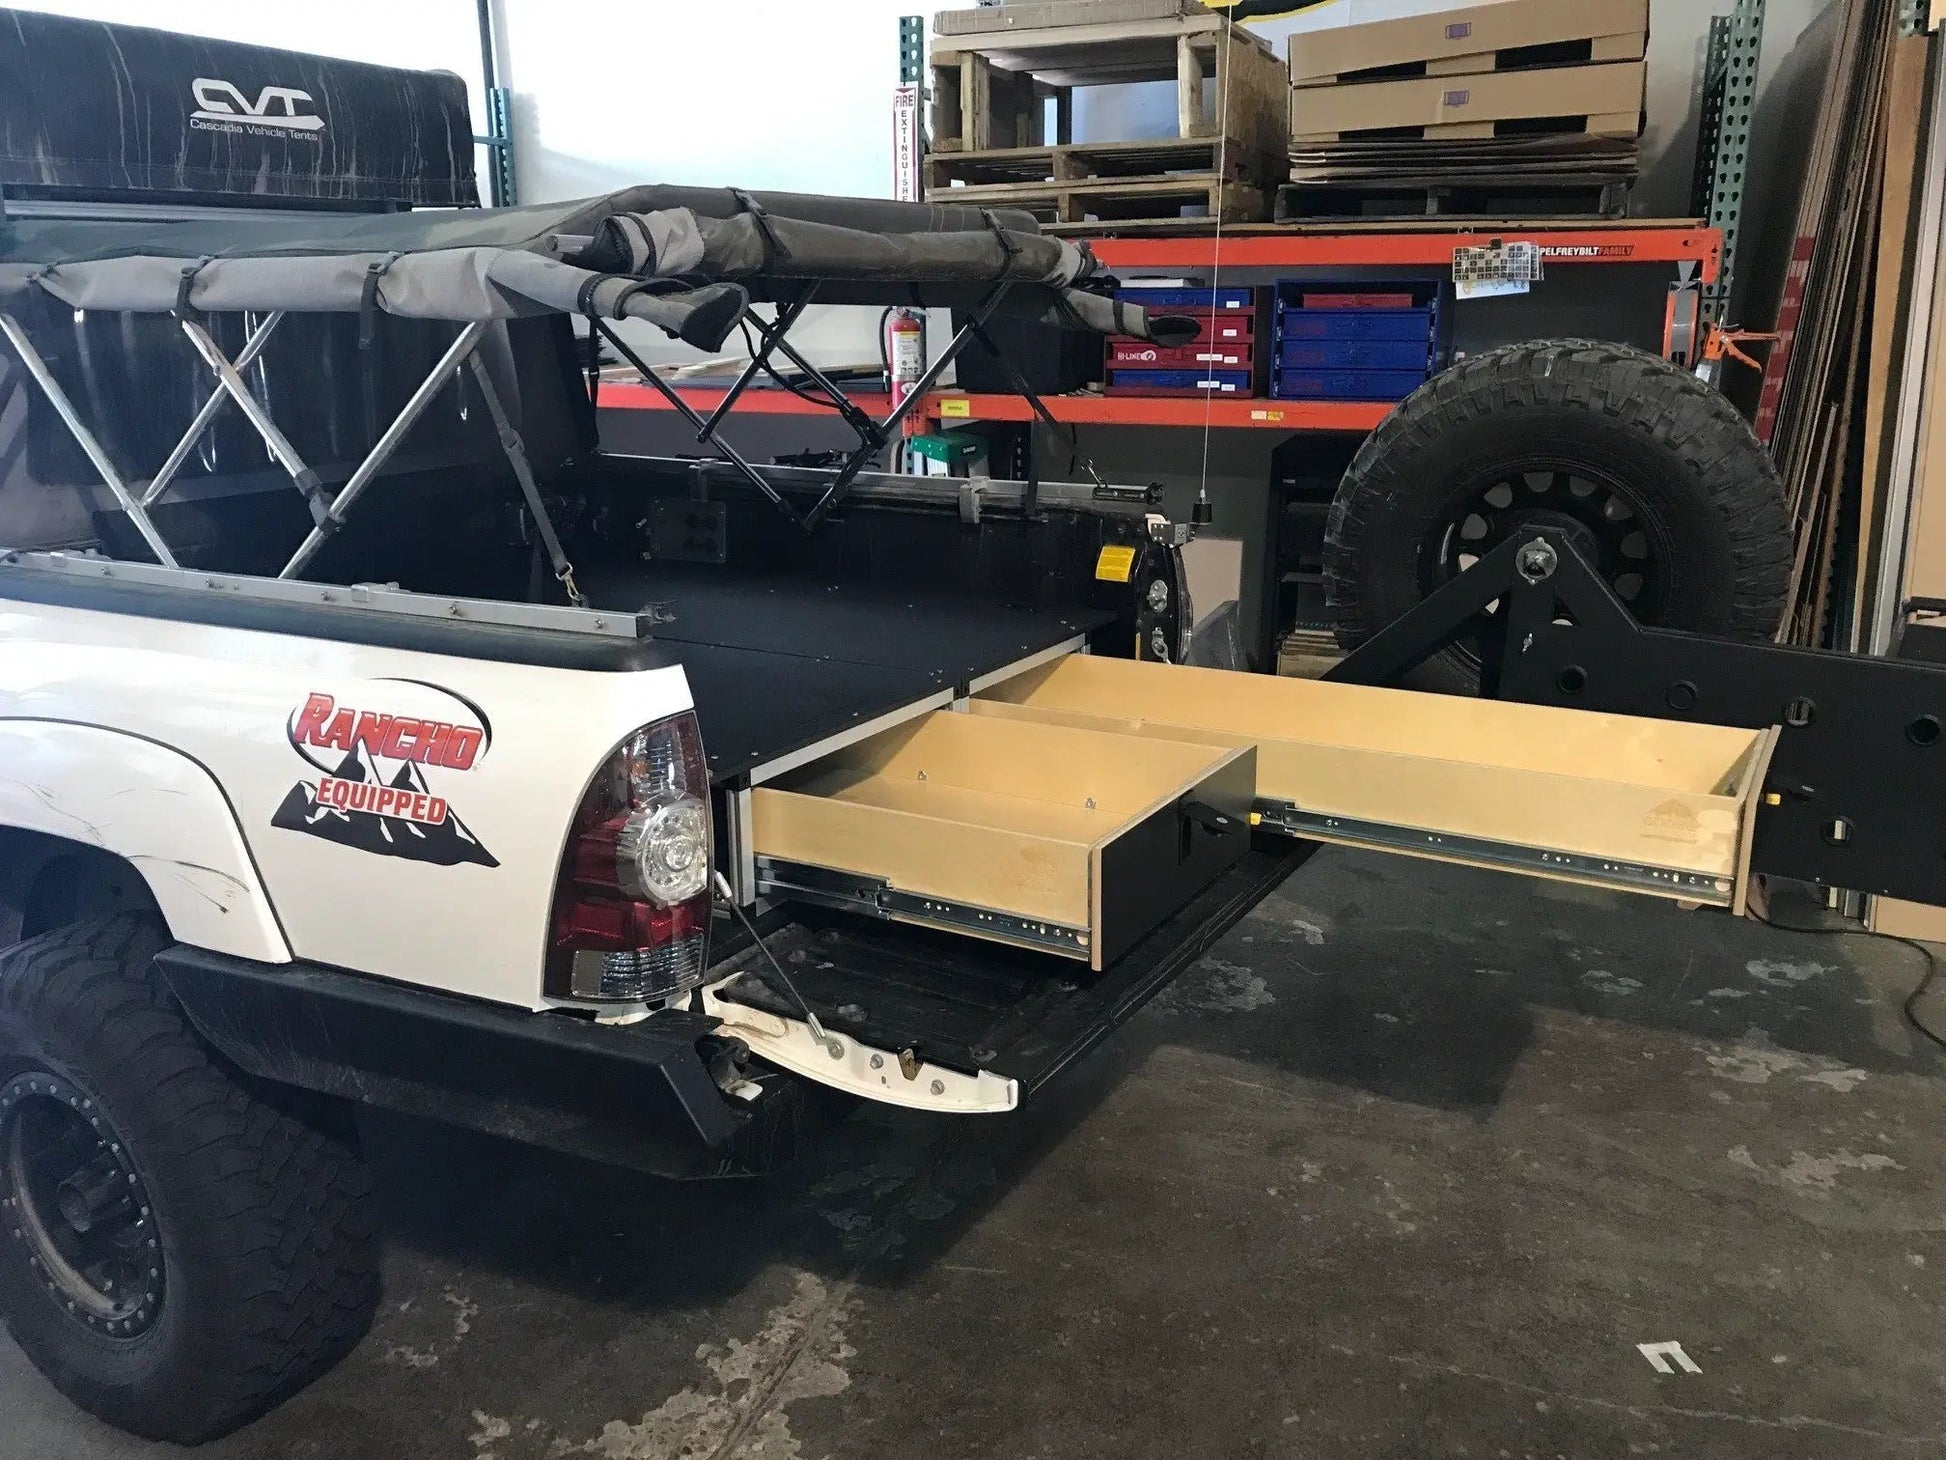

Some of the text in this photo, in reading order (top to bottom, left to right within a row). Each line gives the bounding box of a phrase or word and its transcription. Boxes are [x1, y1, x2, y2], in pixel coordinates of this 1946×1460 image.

[191, 77, 313, 116] CVT
[895, 94, 914, 107] FIRE
[189, 118, 318, 141] Cascadia Vehicle Tents
[901, 109, 909, 202] EXTINGUISHE
[293, 691, 484, 771] RANCHO
[316, 777, 448, 824] EQUIPPED
